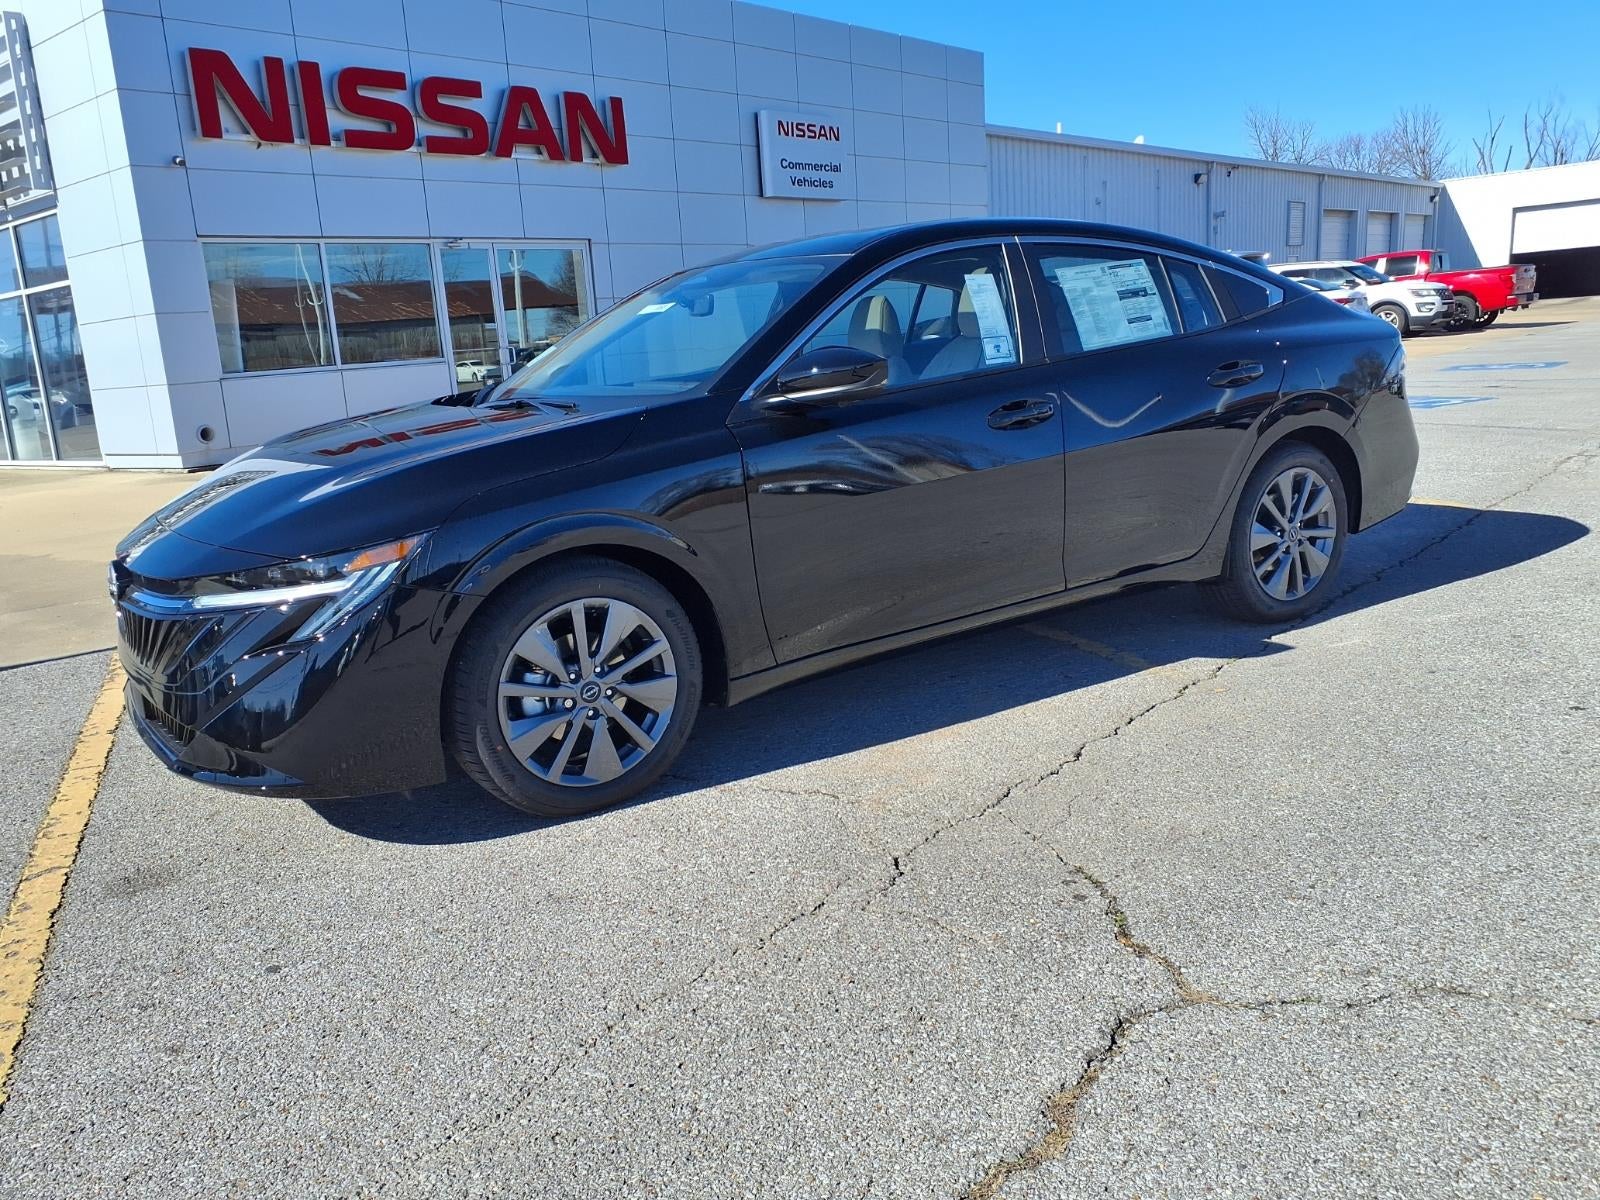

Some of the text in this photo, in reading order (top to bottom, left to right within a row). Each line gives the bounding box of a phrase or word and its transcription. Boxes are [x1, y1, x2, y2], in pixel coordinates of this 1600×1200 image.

[186, 47, 629, 165] NISSAN
[777, 120, 840, 141] NISSAN
[780, 158, 842, 173] Commercial
[789, 175, 834, 189] Vehicles
